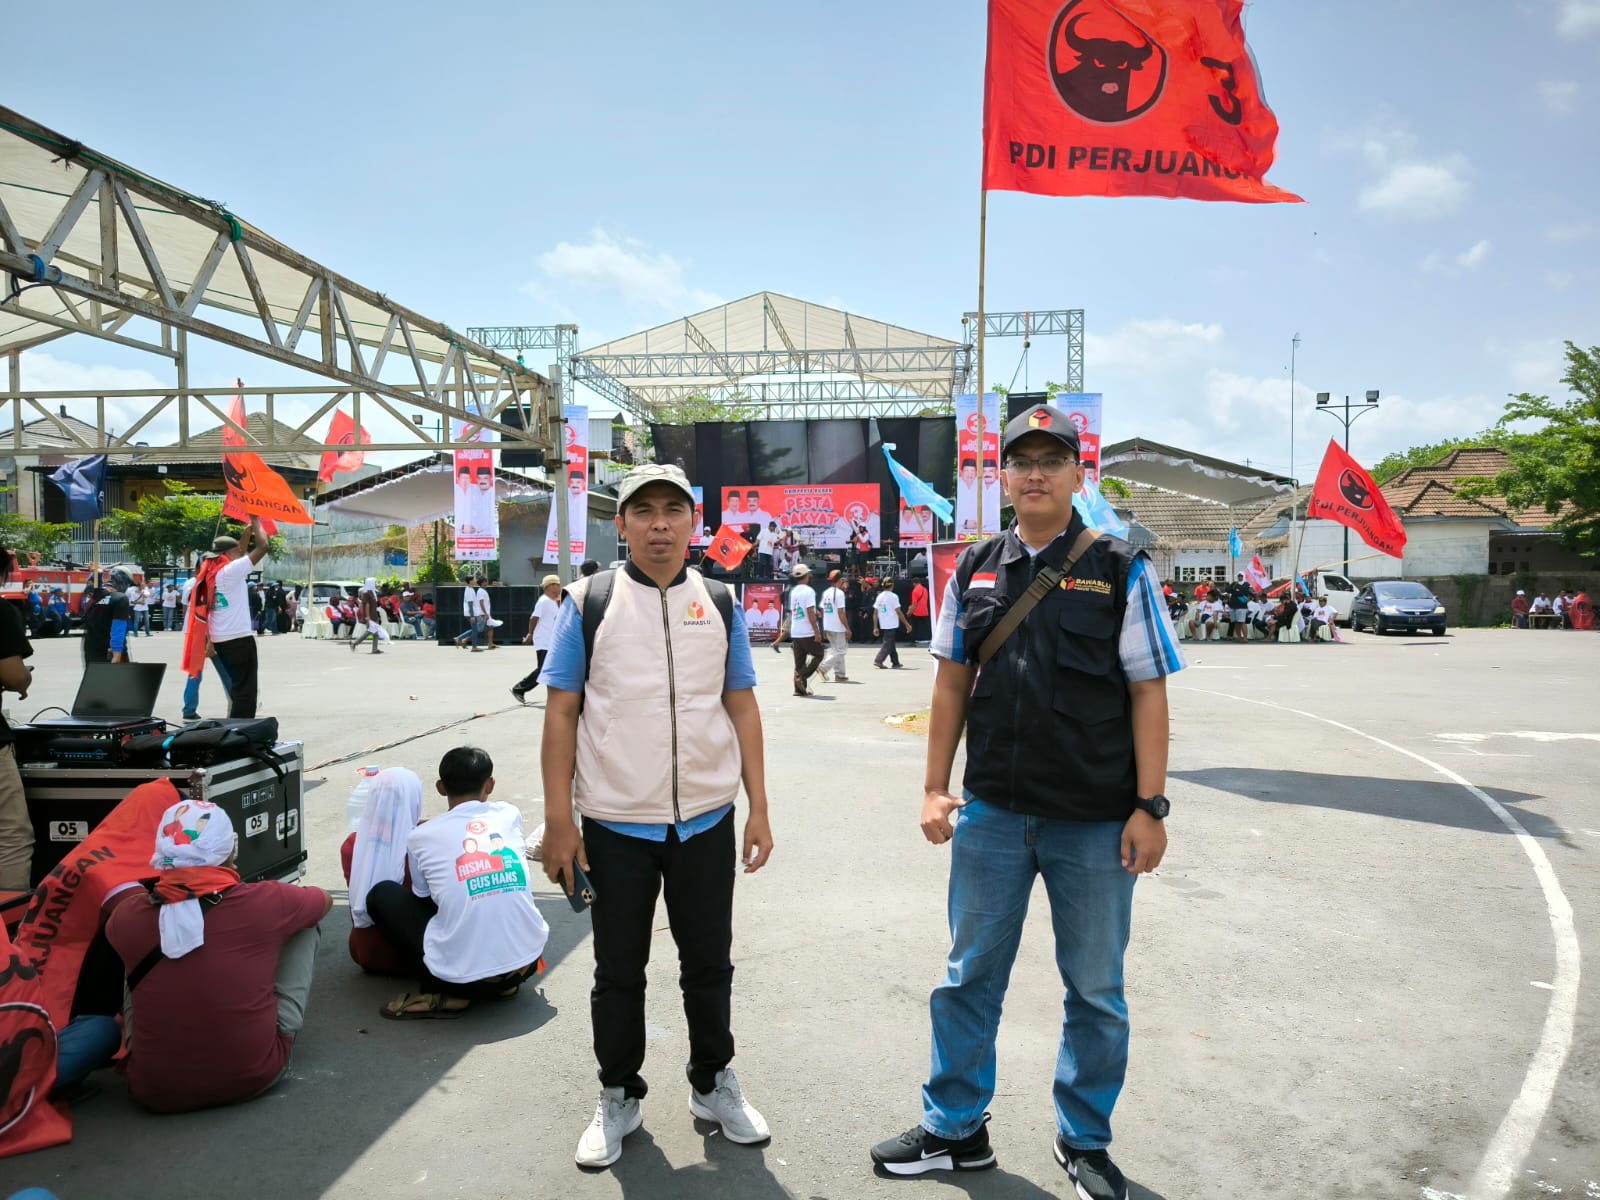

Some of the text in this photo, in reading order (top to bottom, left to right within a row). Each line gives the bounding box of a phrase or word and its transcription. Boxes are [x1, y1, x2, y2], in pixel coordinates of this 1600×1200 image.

[1200, 56, 1243, 125] 3
[1008, 141, 1055, 170] PDI
[785, 496, 833, 510] PESTA
[781, 512, 839, 527] RAKYAT
[1075, 578, 1112, 589] BAWASLU
[58, 822, 77, 836] 05
[250, 816, 263, 829] 05
[458, 859, 492, 877] RISMA
[469, 871, 518, 891] GUS HANS
